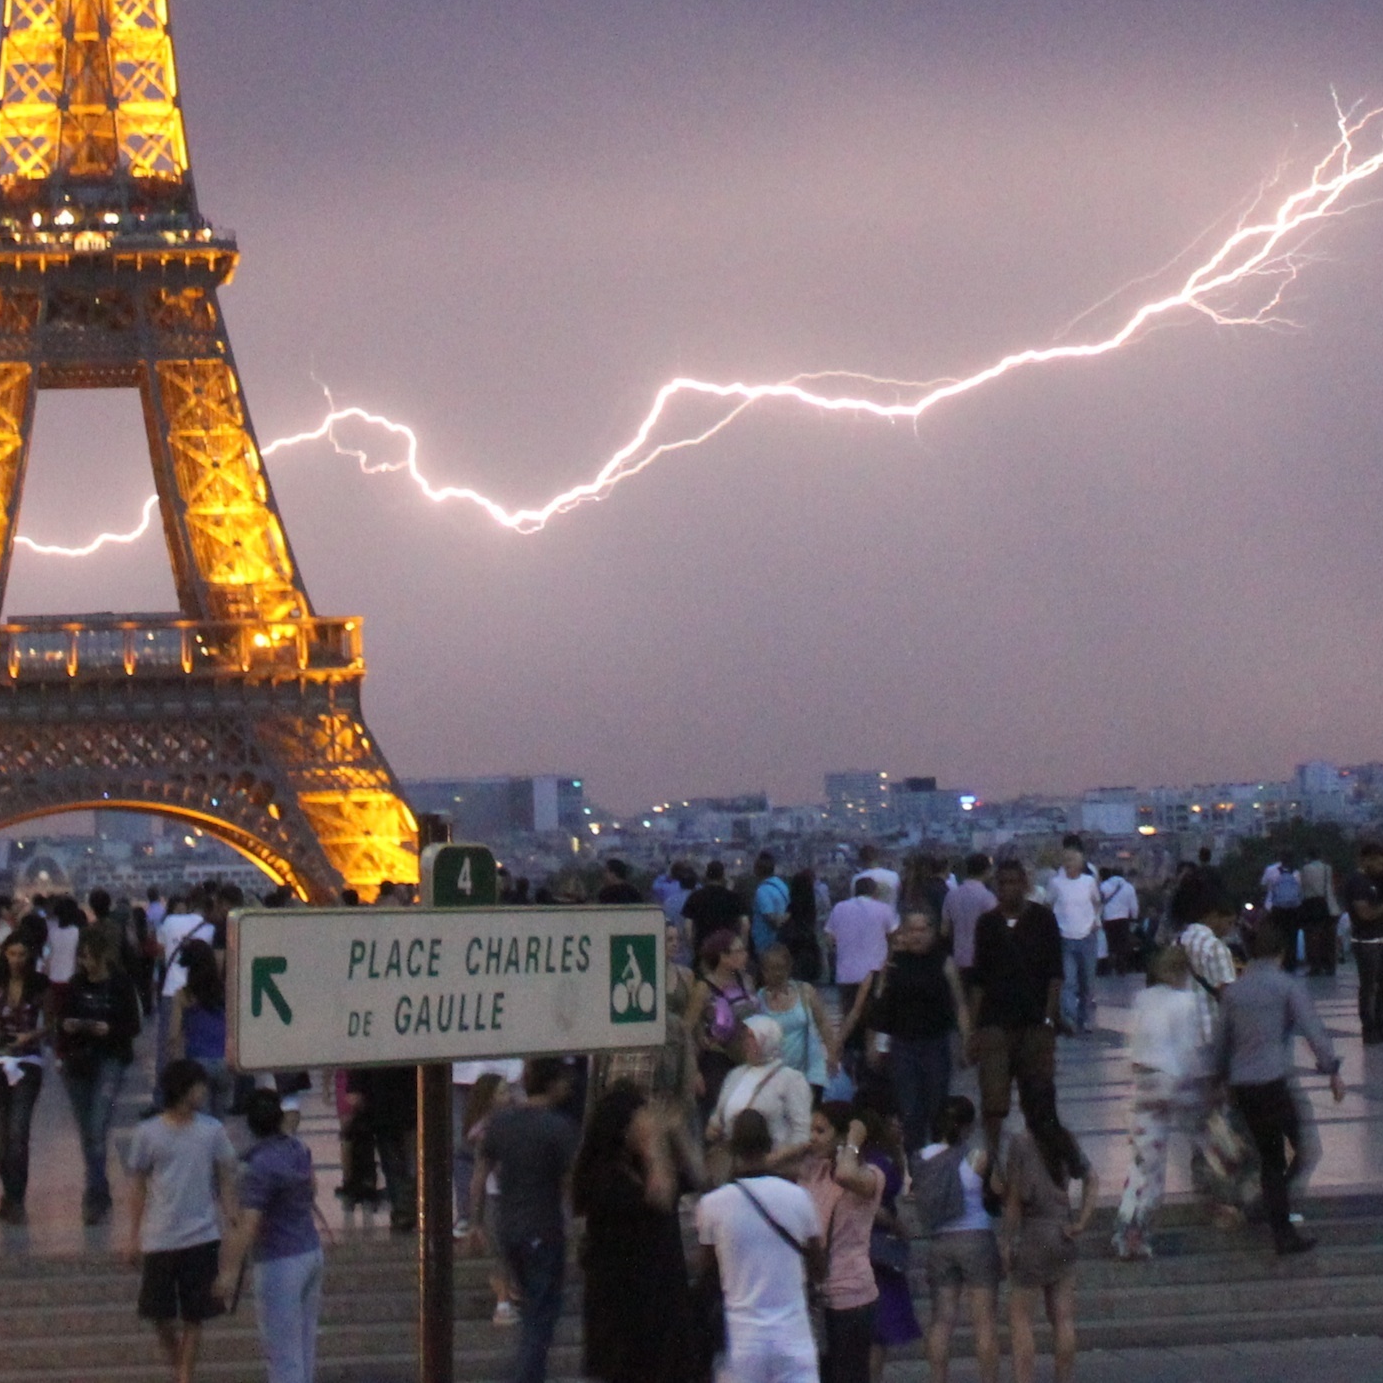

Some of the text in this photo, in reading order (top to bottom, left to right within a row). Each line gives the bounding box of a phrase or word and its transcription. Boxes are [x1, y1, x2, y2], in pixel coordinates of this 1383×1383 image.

[457, 856, 472, 896] 4
[347, 934, 592, 980] PLACE CHARLES
[347, 991, 505, 1037] DE GAULLE
